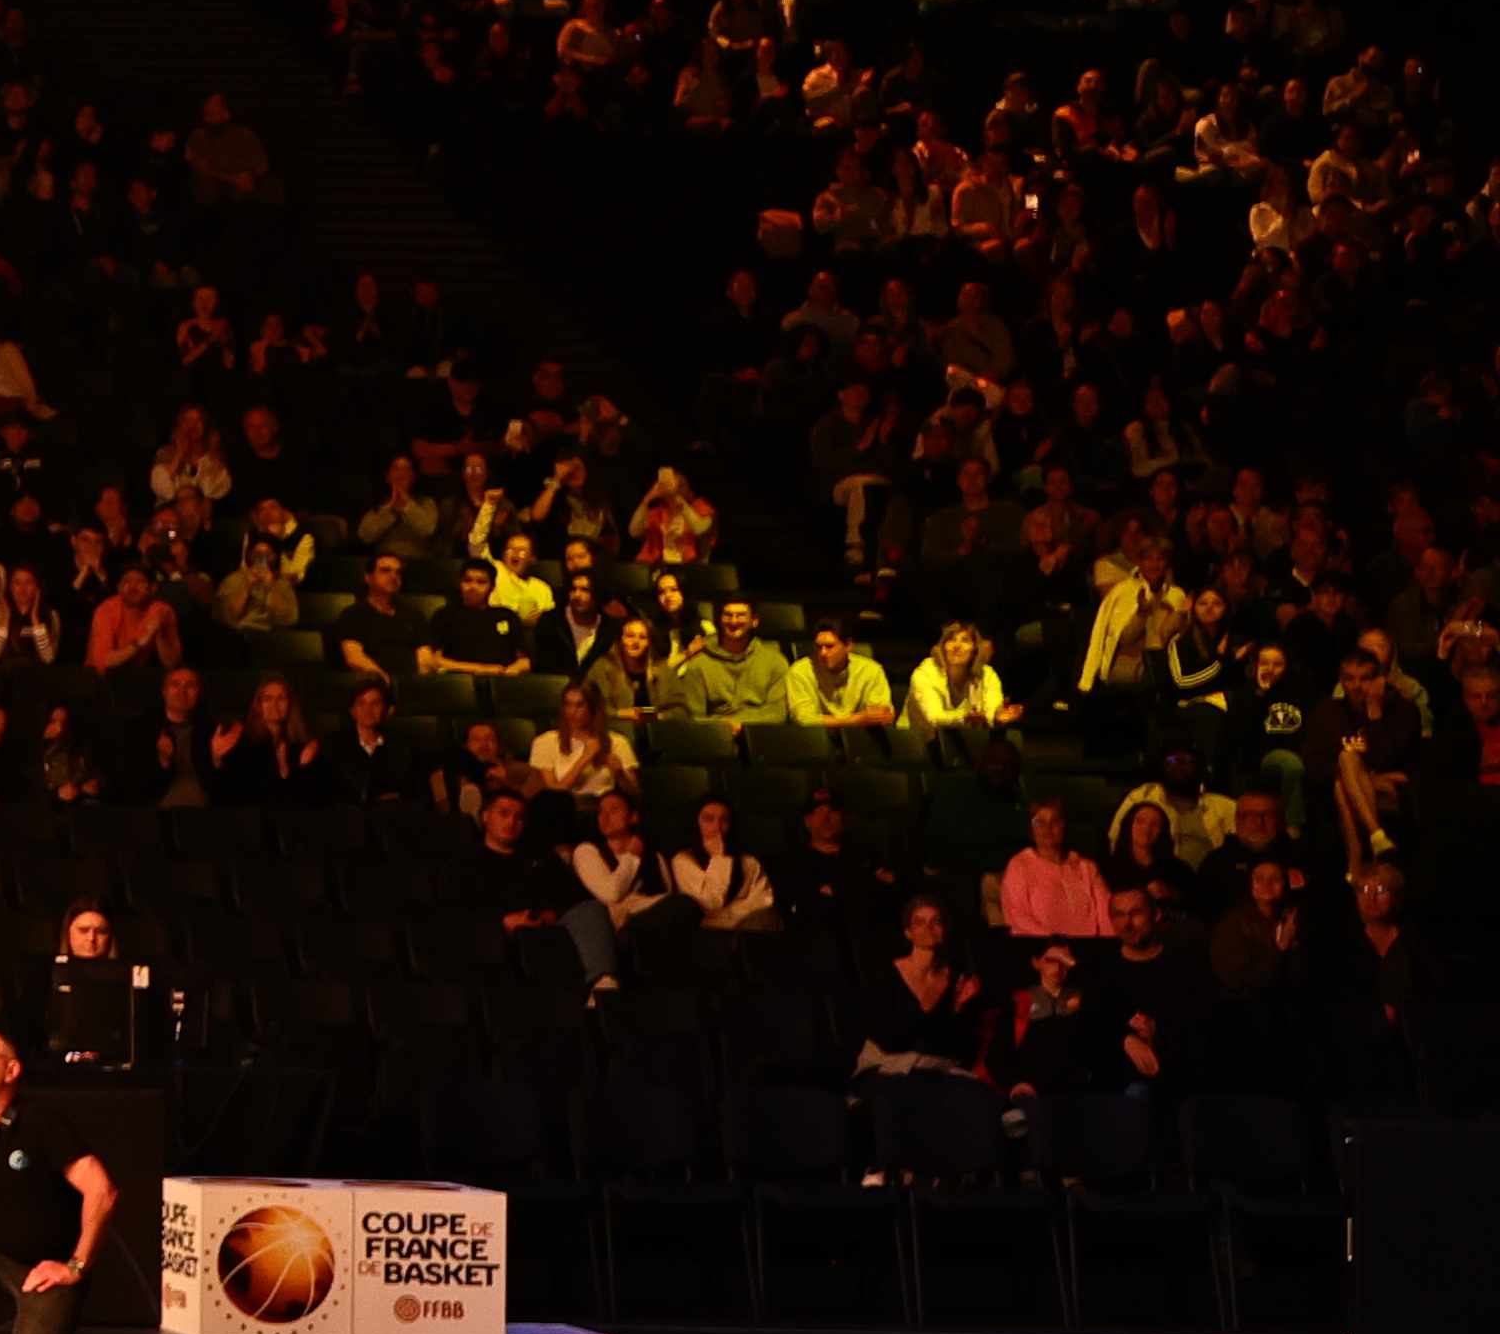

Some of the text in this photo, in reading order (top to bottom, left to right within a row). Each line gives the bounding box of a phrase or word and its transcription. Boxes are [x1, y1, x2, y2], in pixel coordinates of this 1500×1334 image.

[362, 1212, 494, 1238] COUPE DE
[365, 1238, 488, 1260] FRANCE
[358, 1261, 500, 1287] DE BASKET
